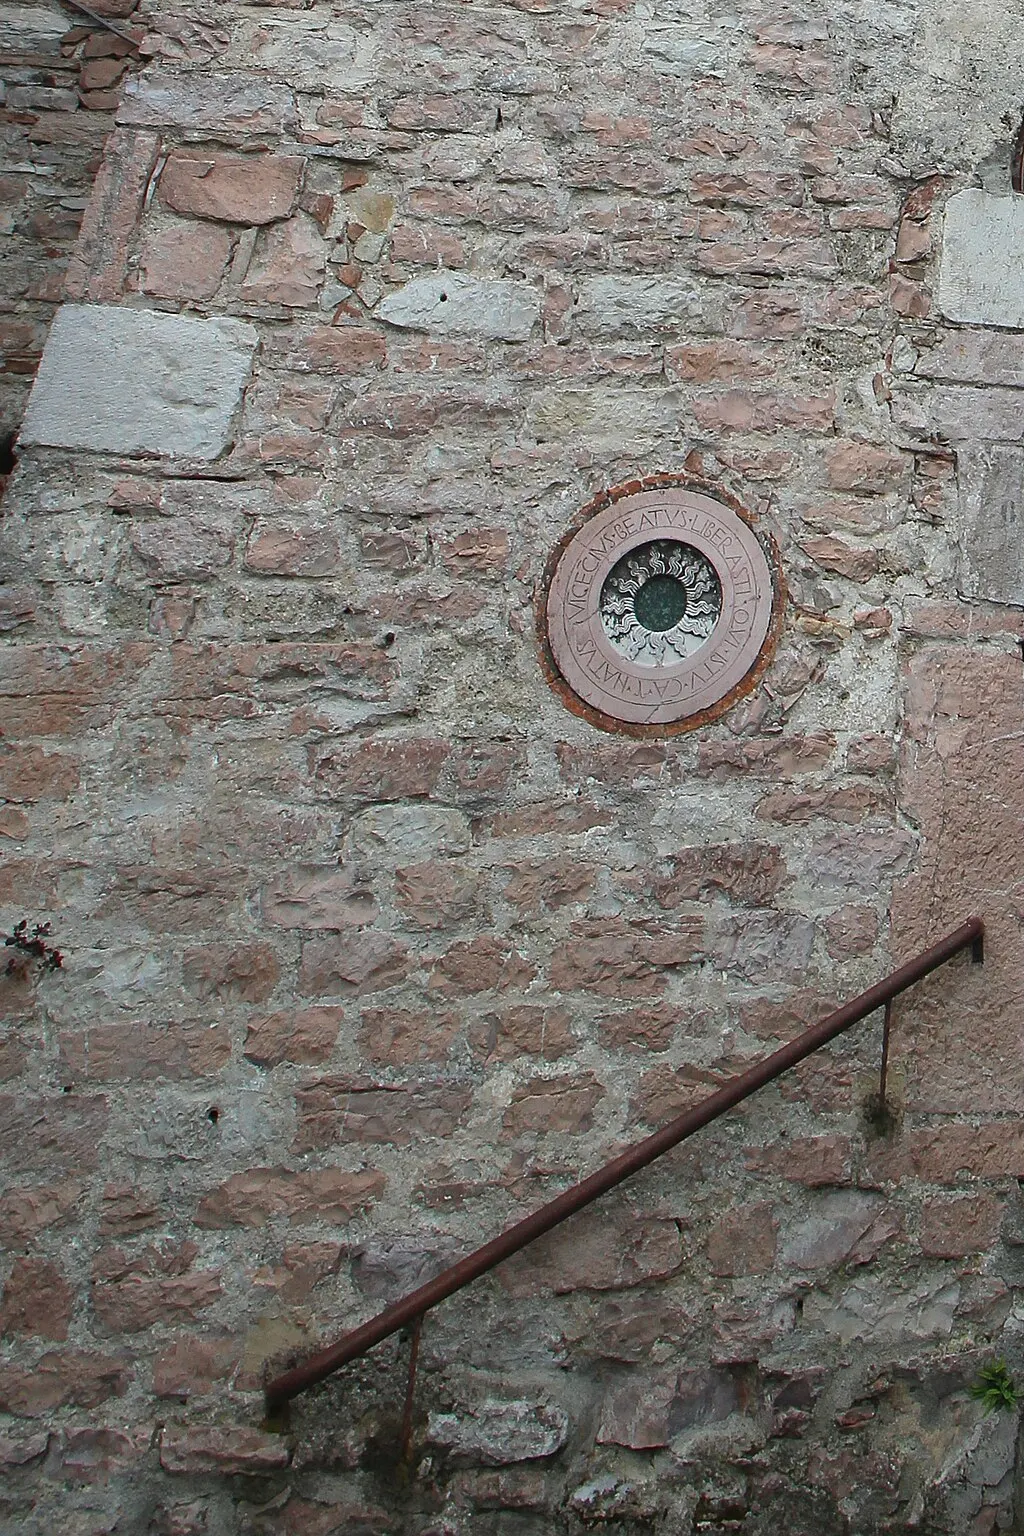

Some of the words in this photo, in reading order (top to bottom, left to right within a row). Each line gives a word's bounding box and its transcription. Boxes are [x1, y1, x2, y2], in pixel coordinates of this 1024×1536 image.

[614, 509, 687, 539] BEATVS
[724, 609, 749, 648] QVI
[576, 639, 629, 693] NATVS
